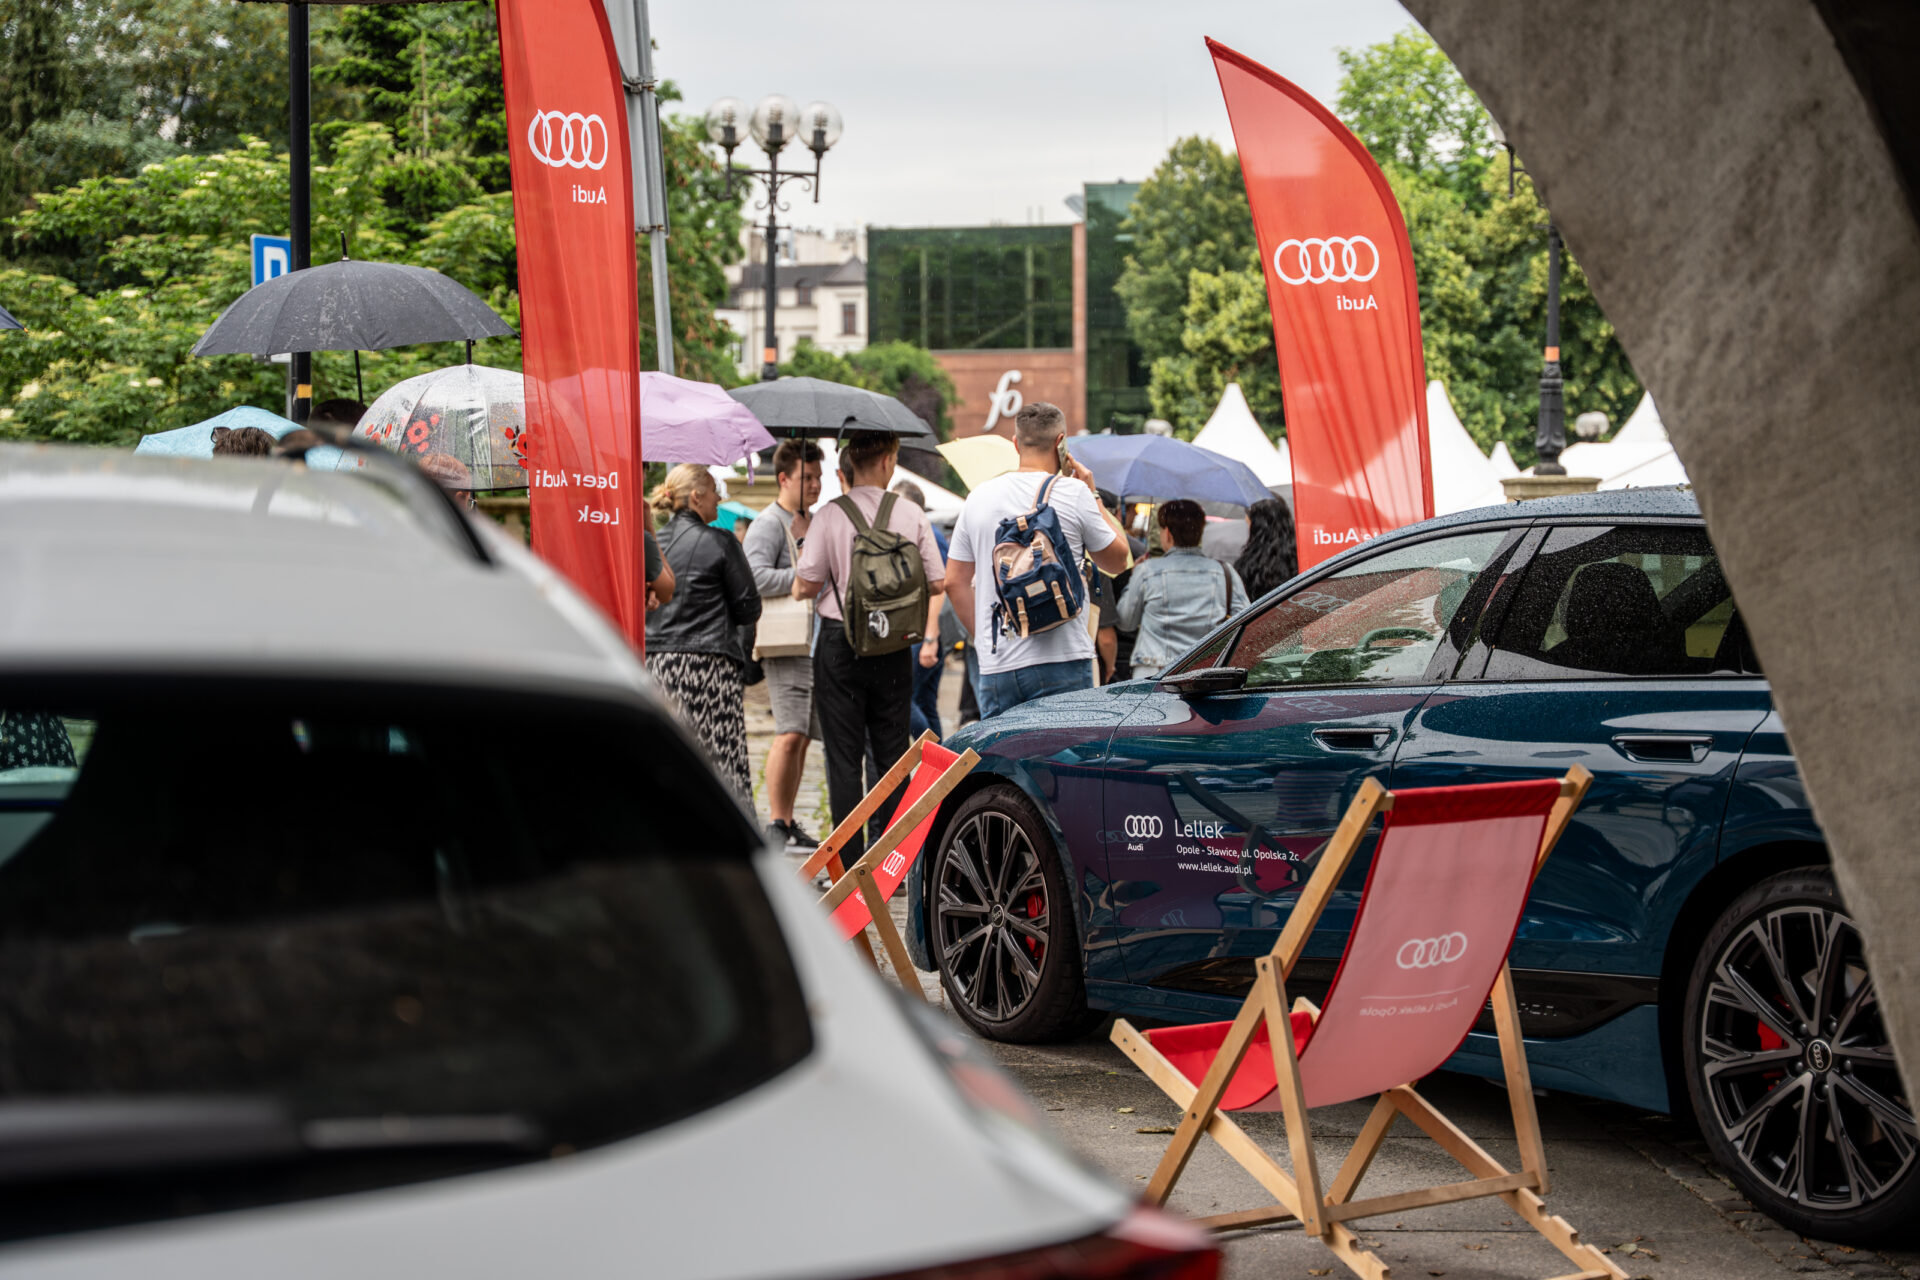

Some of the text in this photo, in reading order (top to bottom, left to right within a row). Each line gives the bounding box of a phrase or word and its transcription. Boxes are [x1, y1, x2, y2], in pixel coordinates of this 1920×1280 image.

[1174, 818, 1224, 839] Lellek
[1127, 843, 1144, 852] Audi
[1176, 844, 1200, 855] Opole
[1206, 846, 1240, 858] Sławice,
[1241, 848, 1252, 858] ul.
[1253, 849, 1287, 861] Opolska
[1289, 851, 1300, 861] 2c
[1177, 862, 1252, 876] www.lellek.audi.pl
